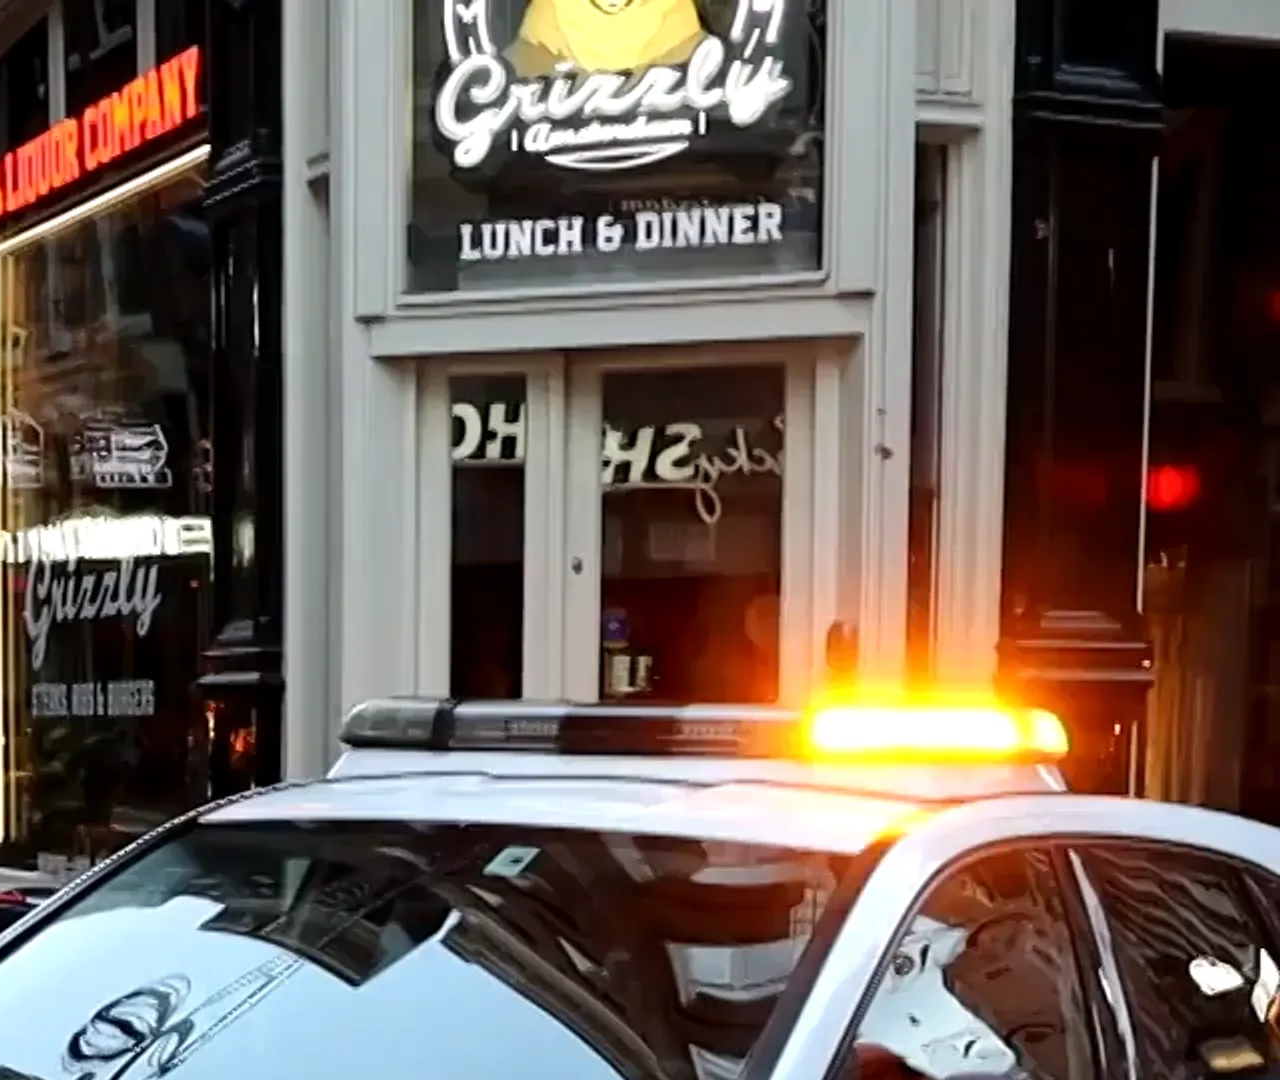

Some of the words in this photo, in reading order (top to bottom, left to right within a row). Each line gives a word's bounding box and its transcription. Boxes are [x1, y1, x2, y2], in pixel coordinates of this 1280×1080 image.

[4, 117, 80, 213] LIQUOR
[82, 44, 199, 172] COMPANY
[435, 35, 790, 168] Grizzly
[459, 214, 586, 261] LUNCH
[595, 214, 625, 253] &
[635, 201, 784, 250] DINNER
[24, 547, 162, 672] Grizzly
